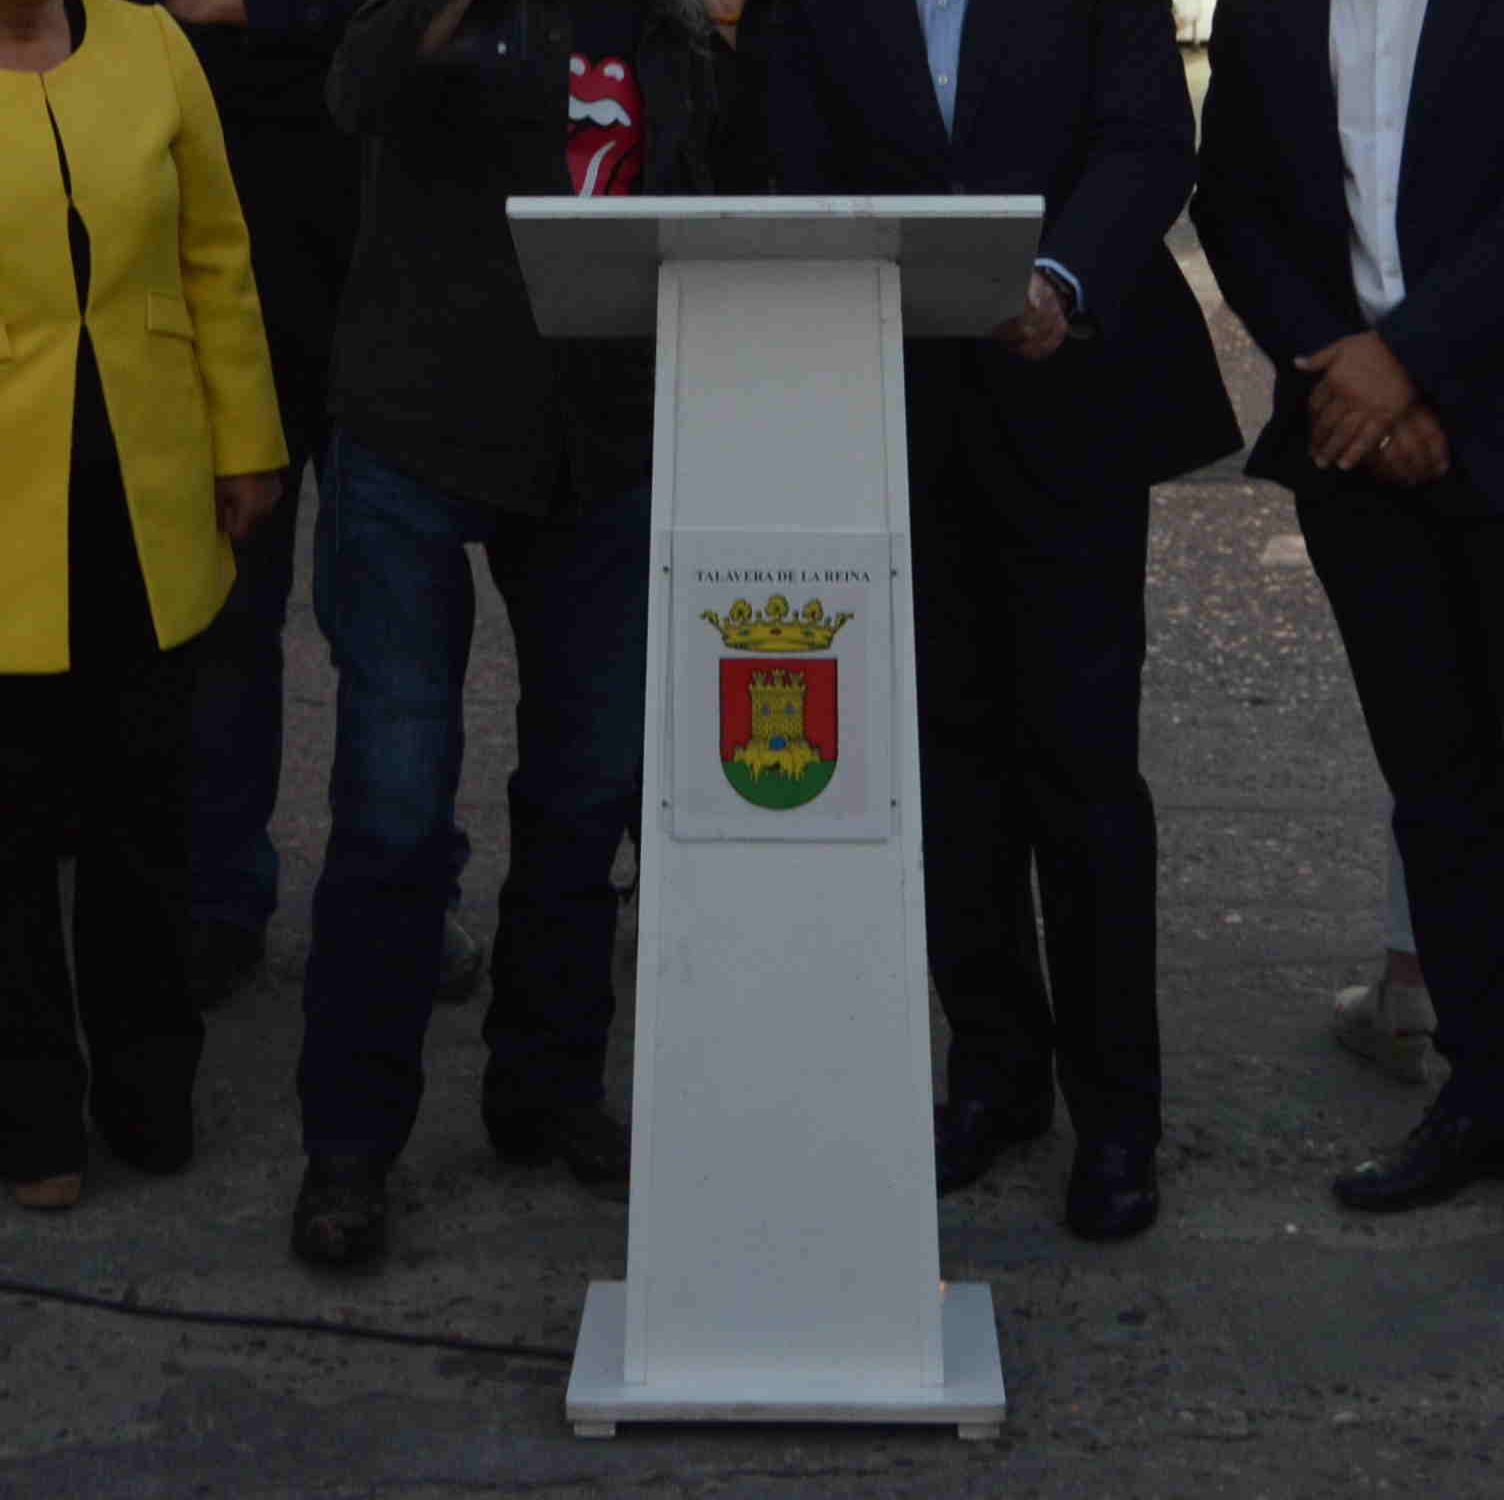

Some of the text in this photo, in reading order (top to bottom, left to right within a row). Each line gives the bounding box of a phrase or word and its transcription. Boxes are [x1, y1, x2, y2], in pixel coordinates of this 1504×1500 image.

[696, 570, 872, 583] TALAVERA DE LA REINA
